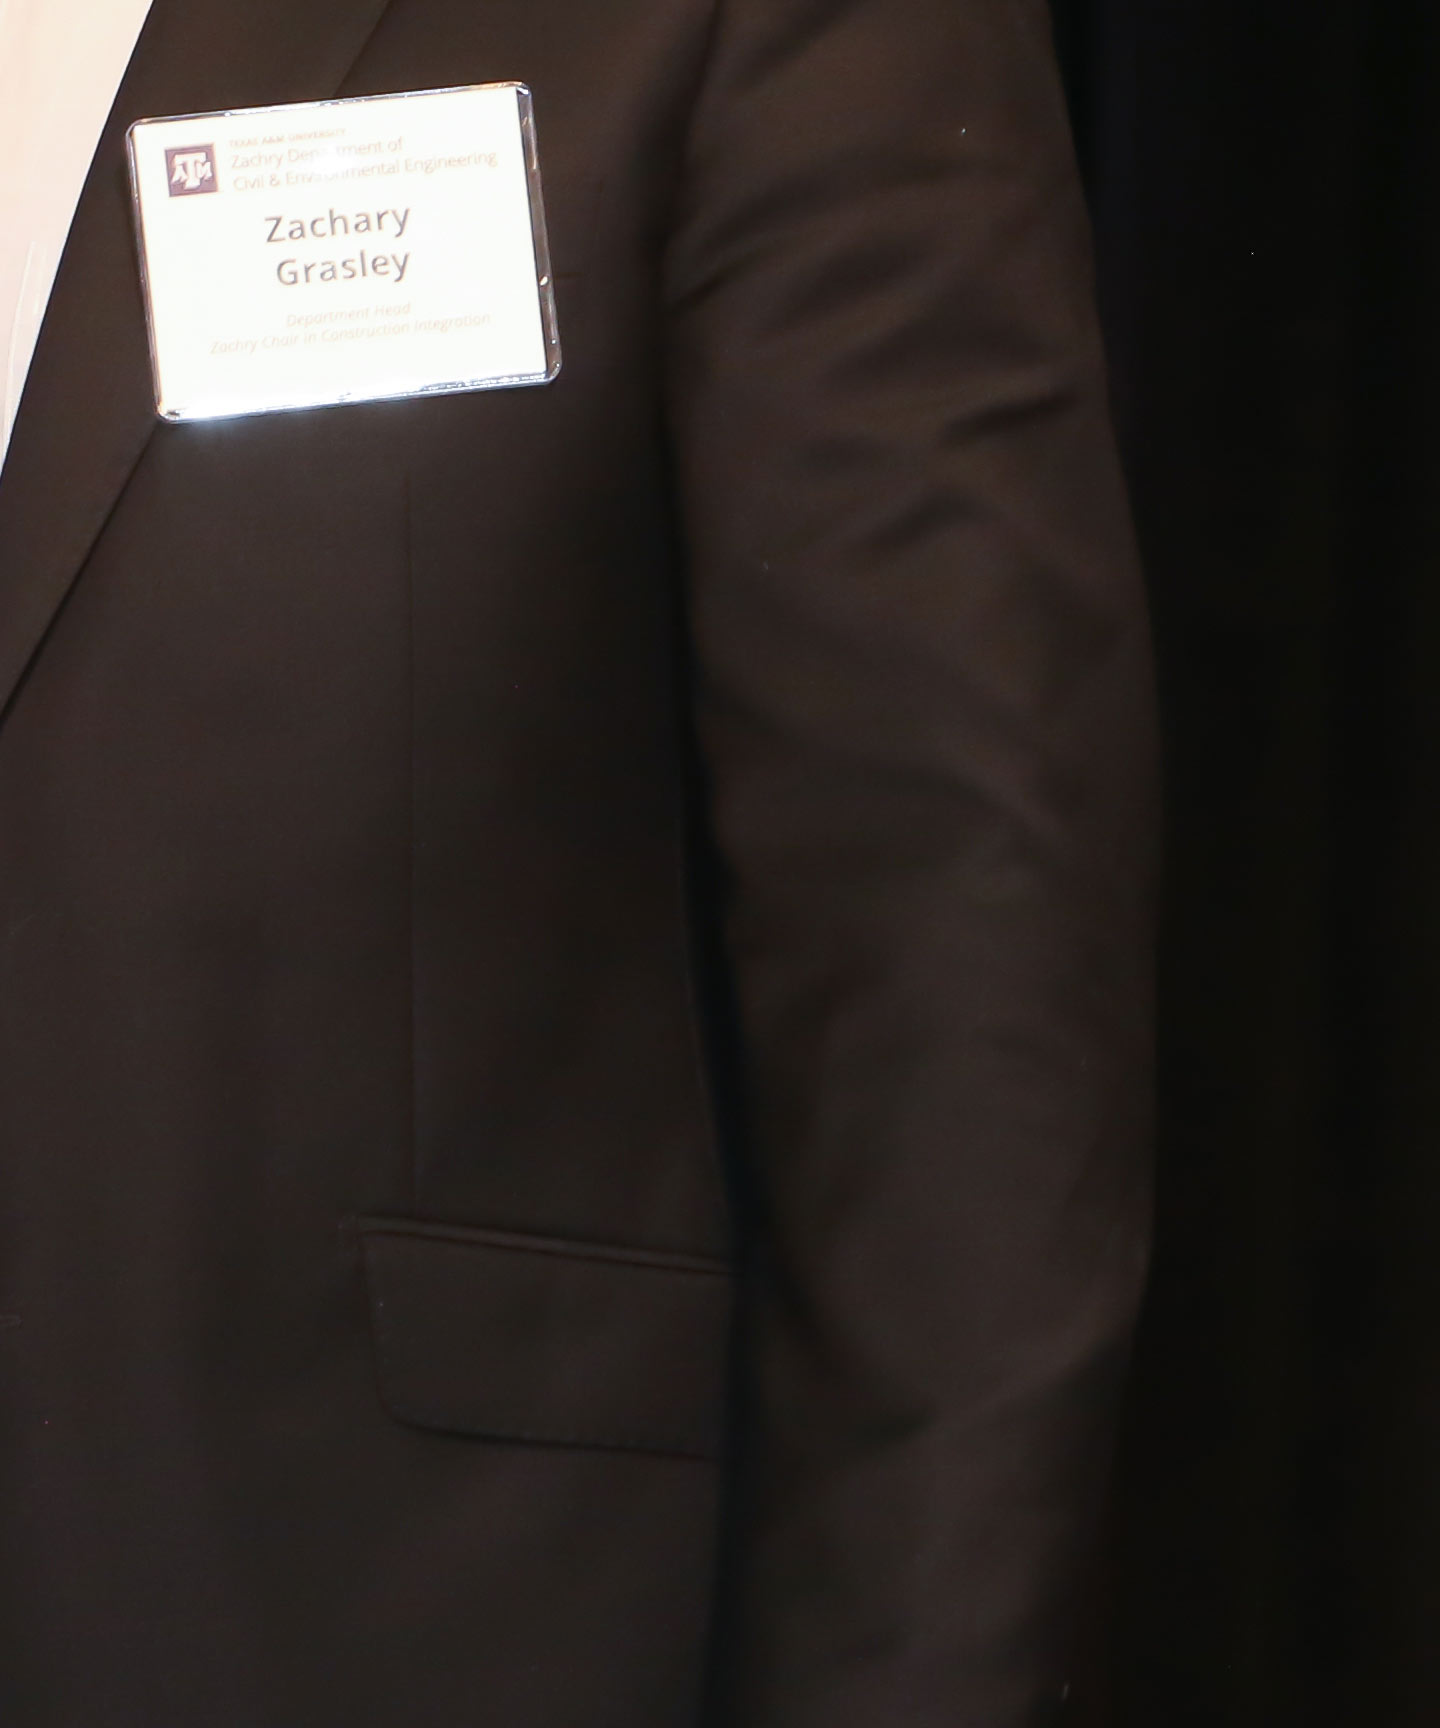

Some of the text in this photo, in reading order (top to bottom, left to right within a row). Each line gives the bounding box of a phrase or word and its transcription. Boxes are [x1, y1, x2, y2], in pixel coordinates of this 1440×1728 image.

[231, 136, 404, 170] Zachry Deptment of
[232, 175, 265, 192] Civil
[269, 173, 281, 188] &
[405, 151, 498, 176] Engineering
[264, 207, 411, 244] Zachary
[276, 249, 411, 287] Grasley
[286, 301, 412, 328] Department Head
[209, 312, 492, 356] Zachry Chair in Construction Integration
